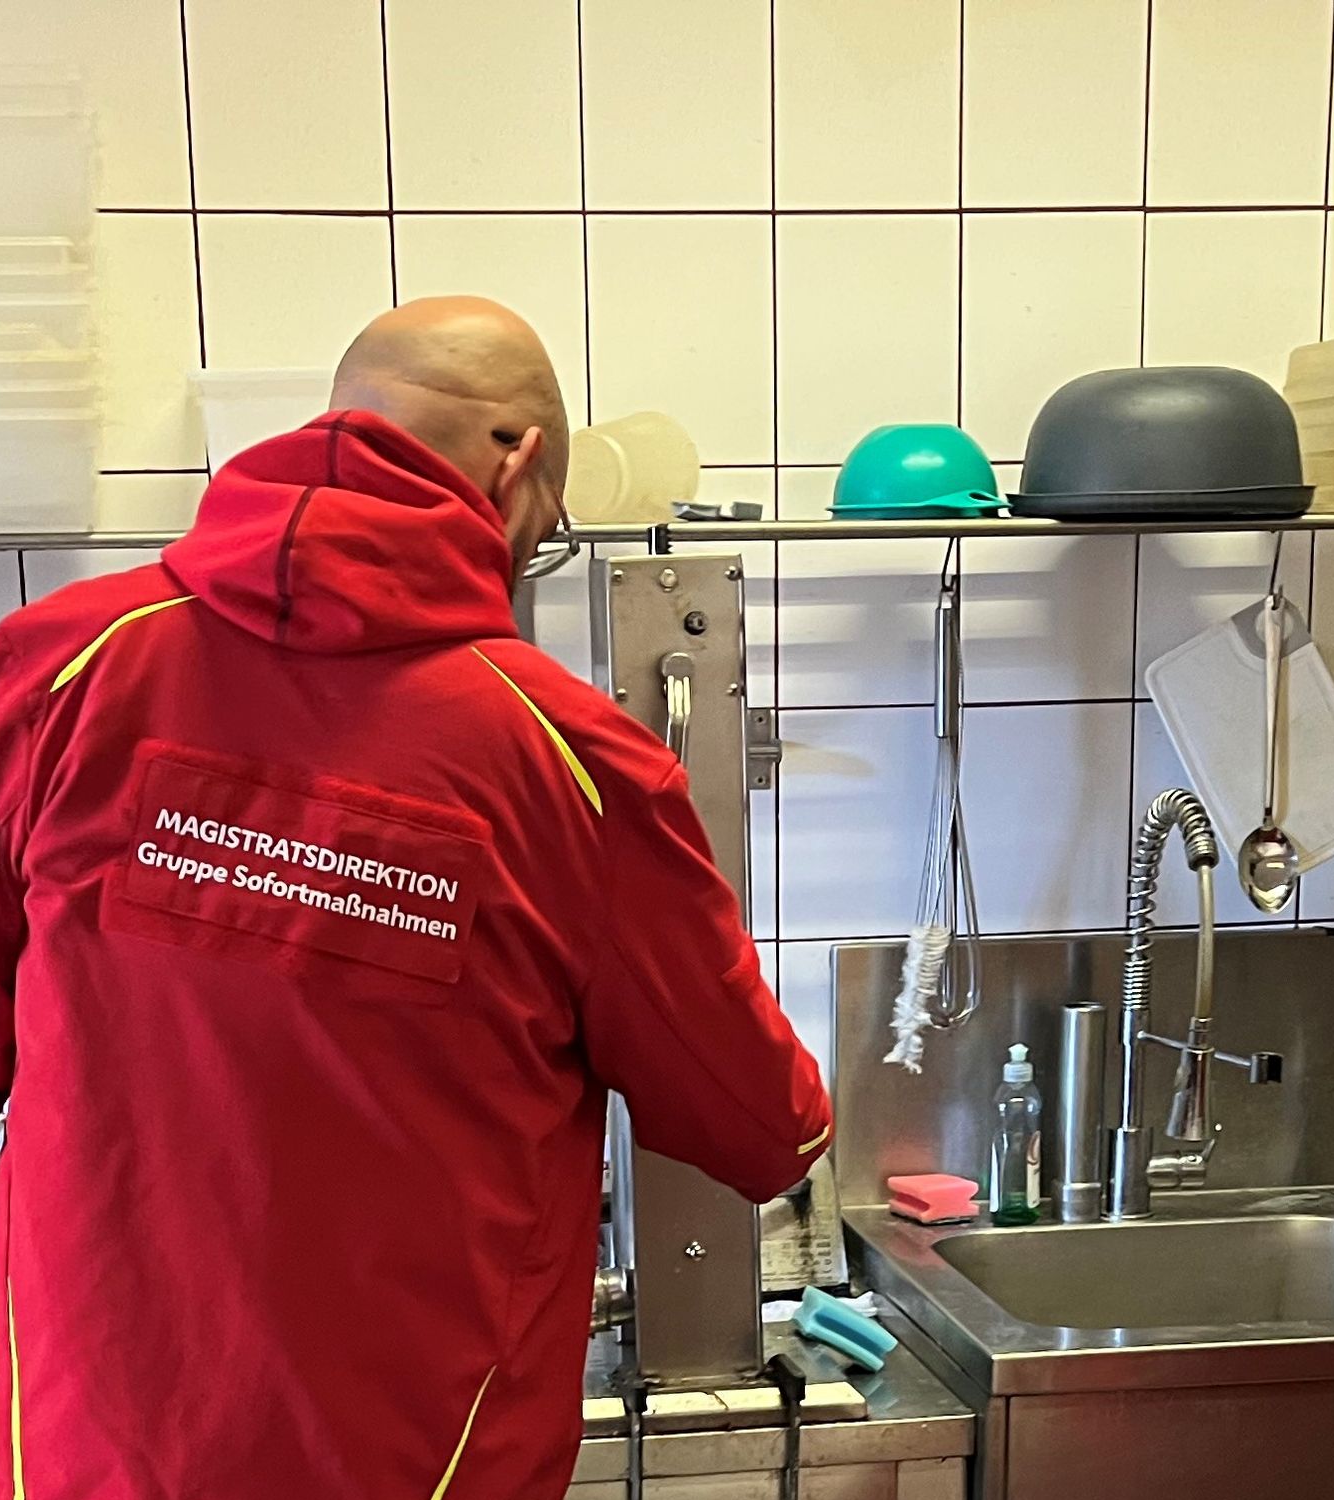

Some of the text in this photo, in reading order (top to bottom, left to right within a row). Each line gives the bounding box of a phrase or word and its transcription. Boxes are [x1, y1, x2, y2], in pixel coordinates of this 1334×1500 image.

[136, 841, 459, 941] Gruppe Sofortmaßnahmen
[154, 807, 459, 903] MAGISTRATSDIREKTION
